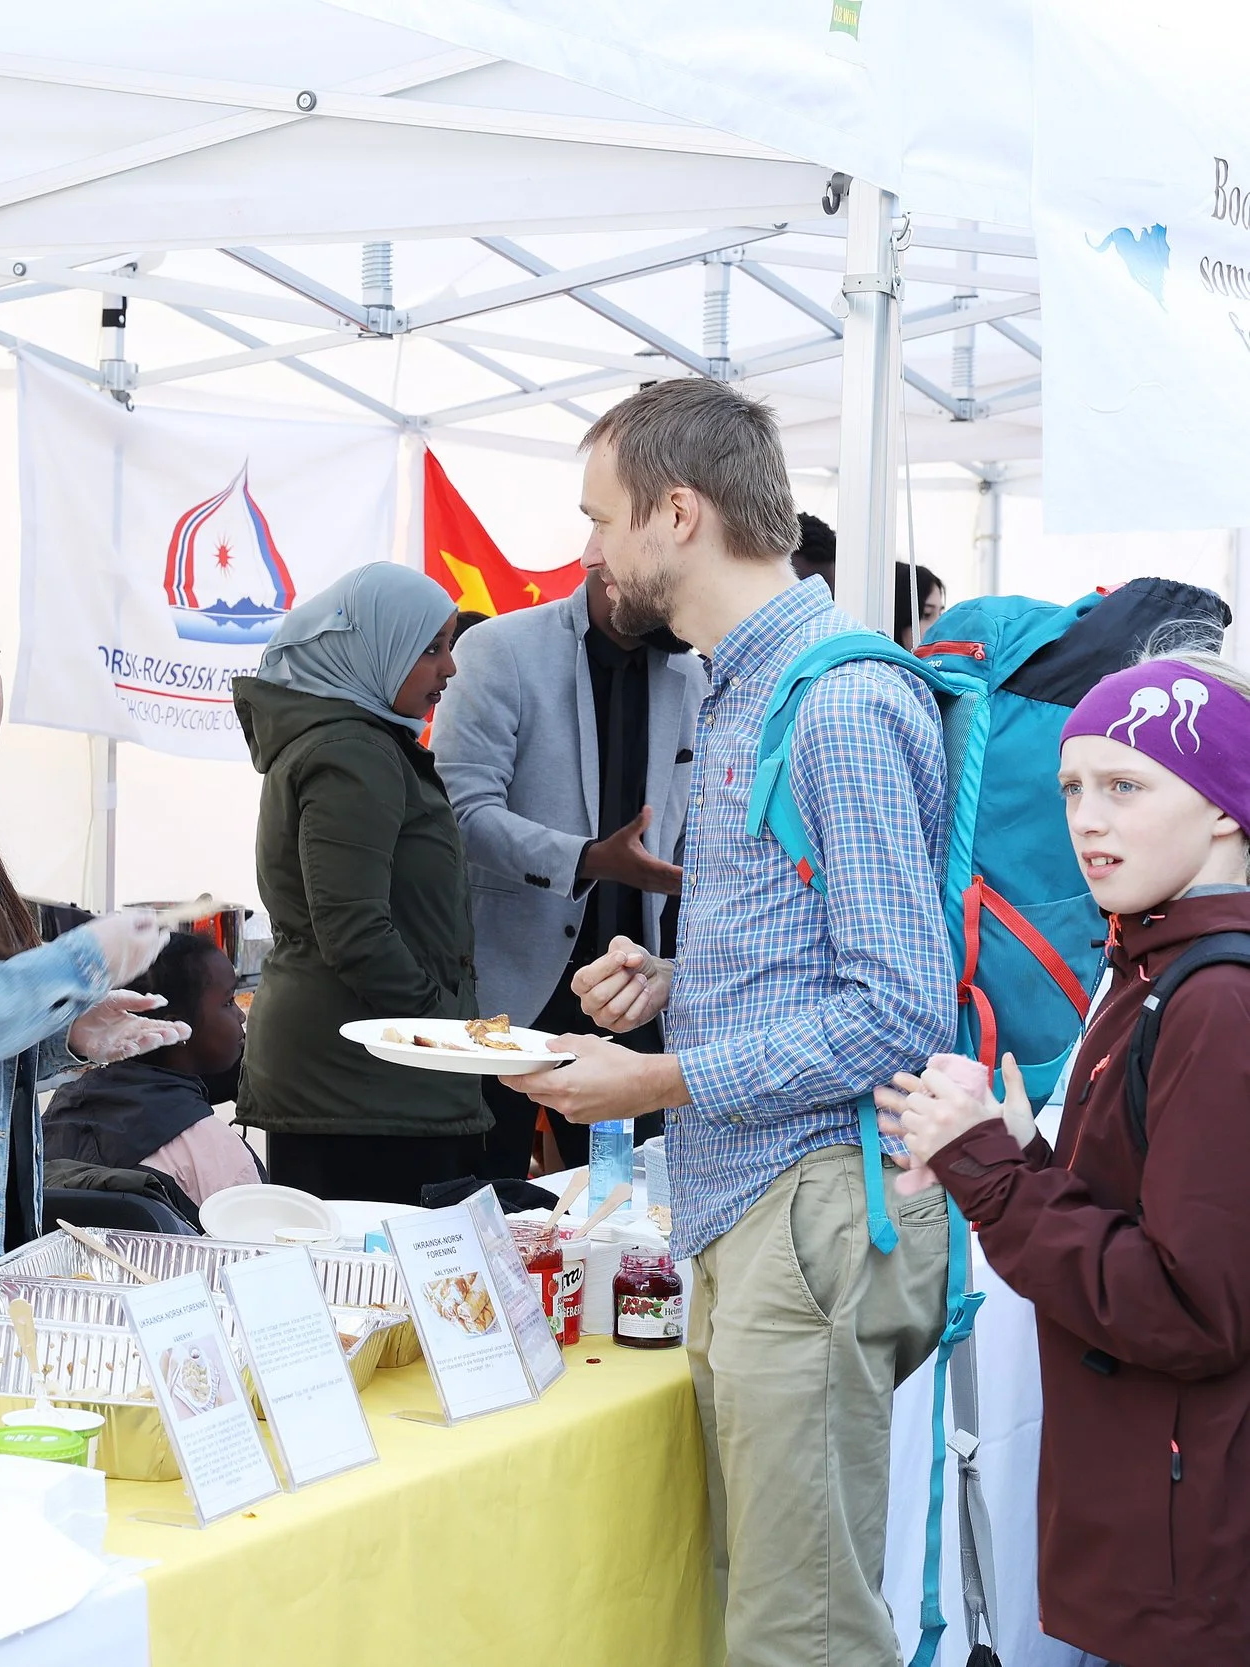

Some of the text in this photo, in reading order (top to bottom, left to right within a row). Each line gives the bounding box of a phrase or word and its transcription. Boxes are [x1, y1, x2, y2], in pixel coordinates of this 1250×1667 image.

[217, 667, 257, 692] FO
[121, 696, 220, 731] ЖСКО-РУССКОЕ
[412, 1233, 464, 1251] UKRAINSK-NORSK
[426, 1246, 457, 1259] FORENING
